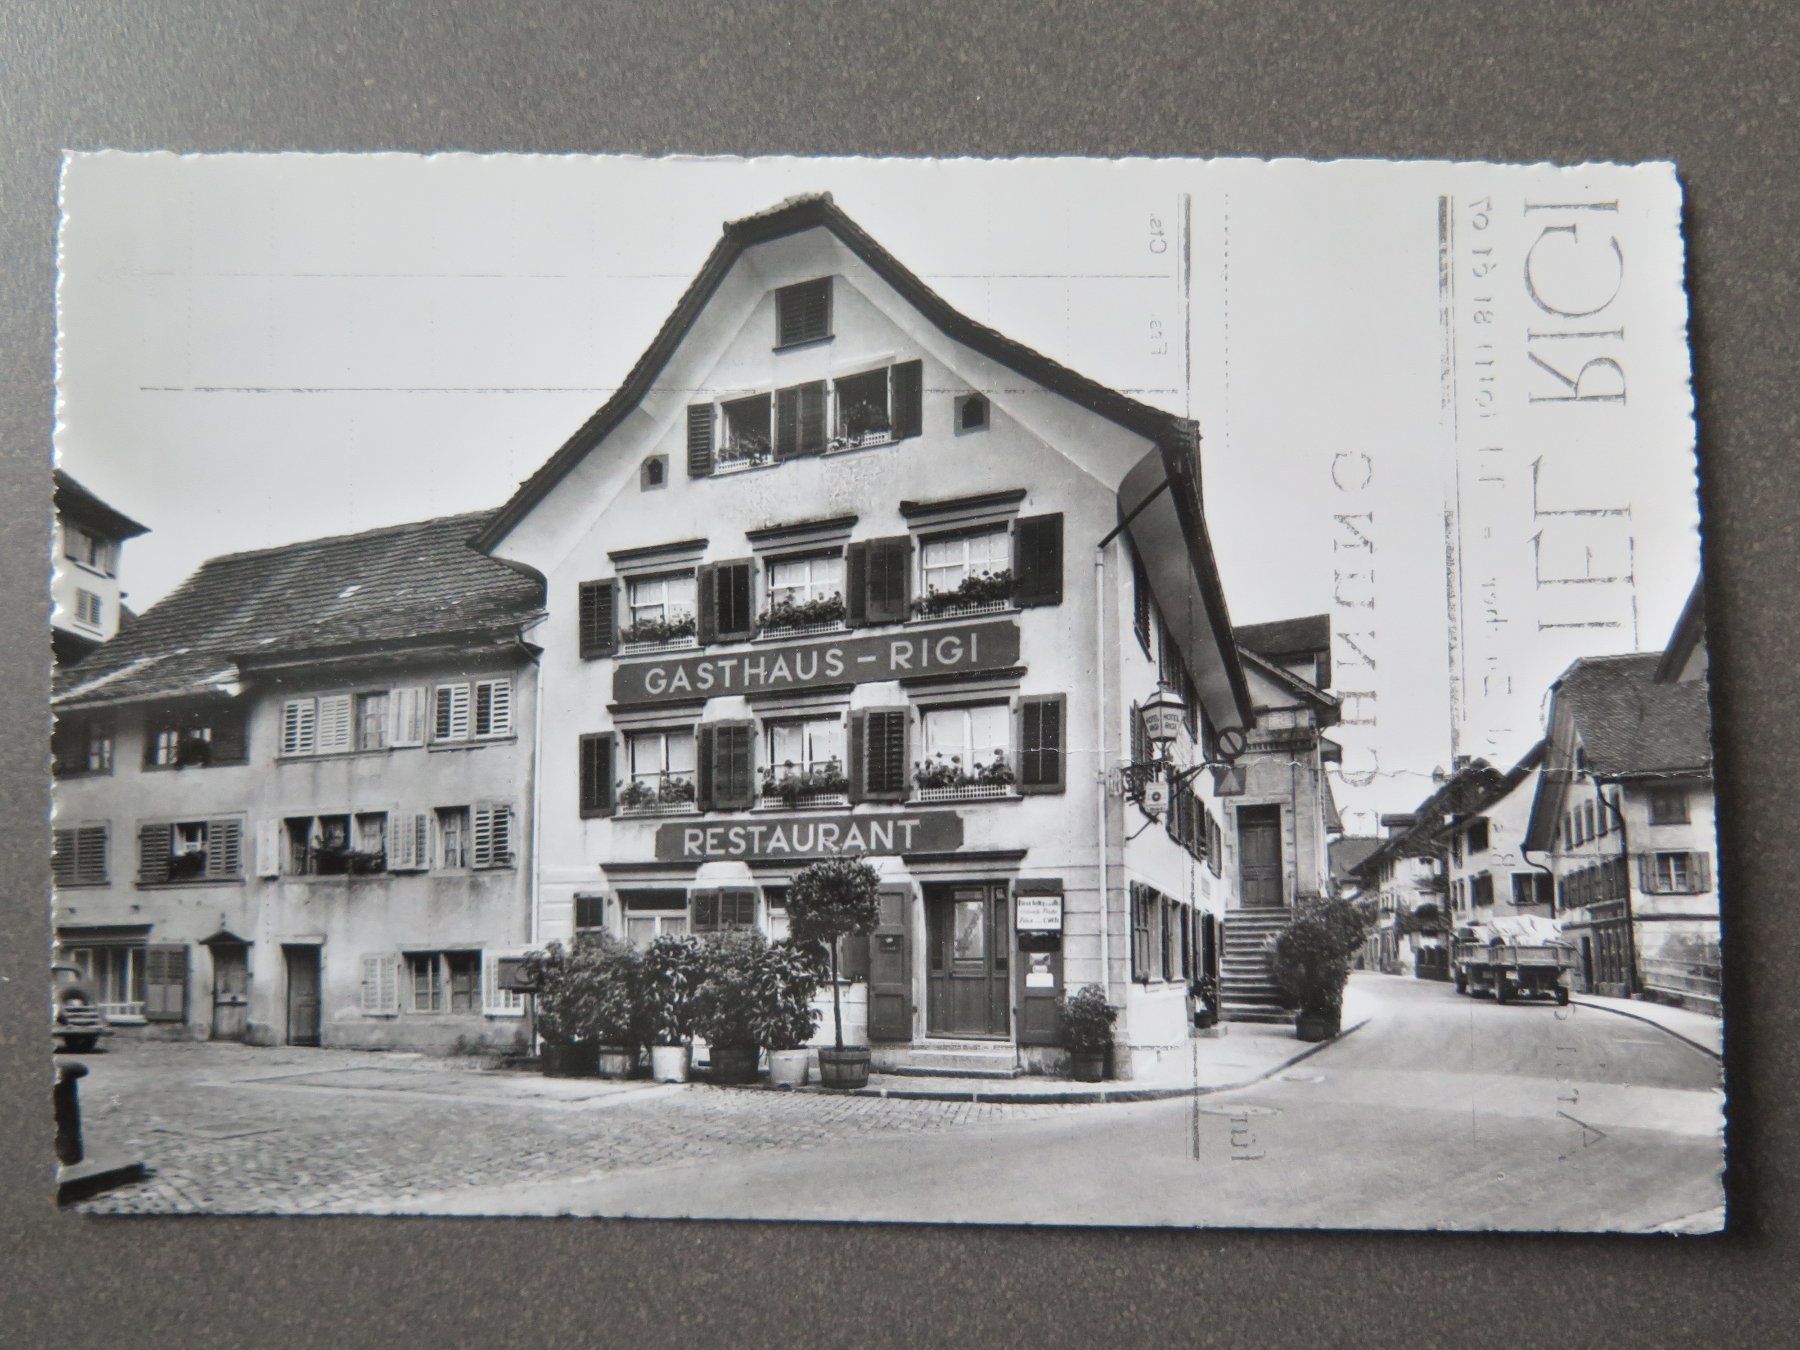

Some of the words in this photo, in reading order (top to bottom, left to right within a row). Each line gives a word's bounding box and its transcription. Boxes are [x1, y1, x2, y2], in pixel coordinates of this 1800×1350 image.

[645, 648, 844, 695] GASTHAUS
[890, 633, 977, 670] RIGI
[1163, 713, 1180, 722] HOTEL
[683, 819, 921, 856] RESTAURANT
